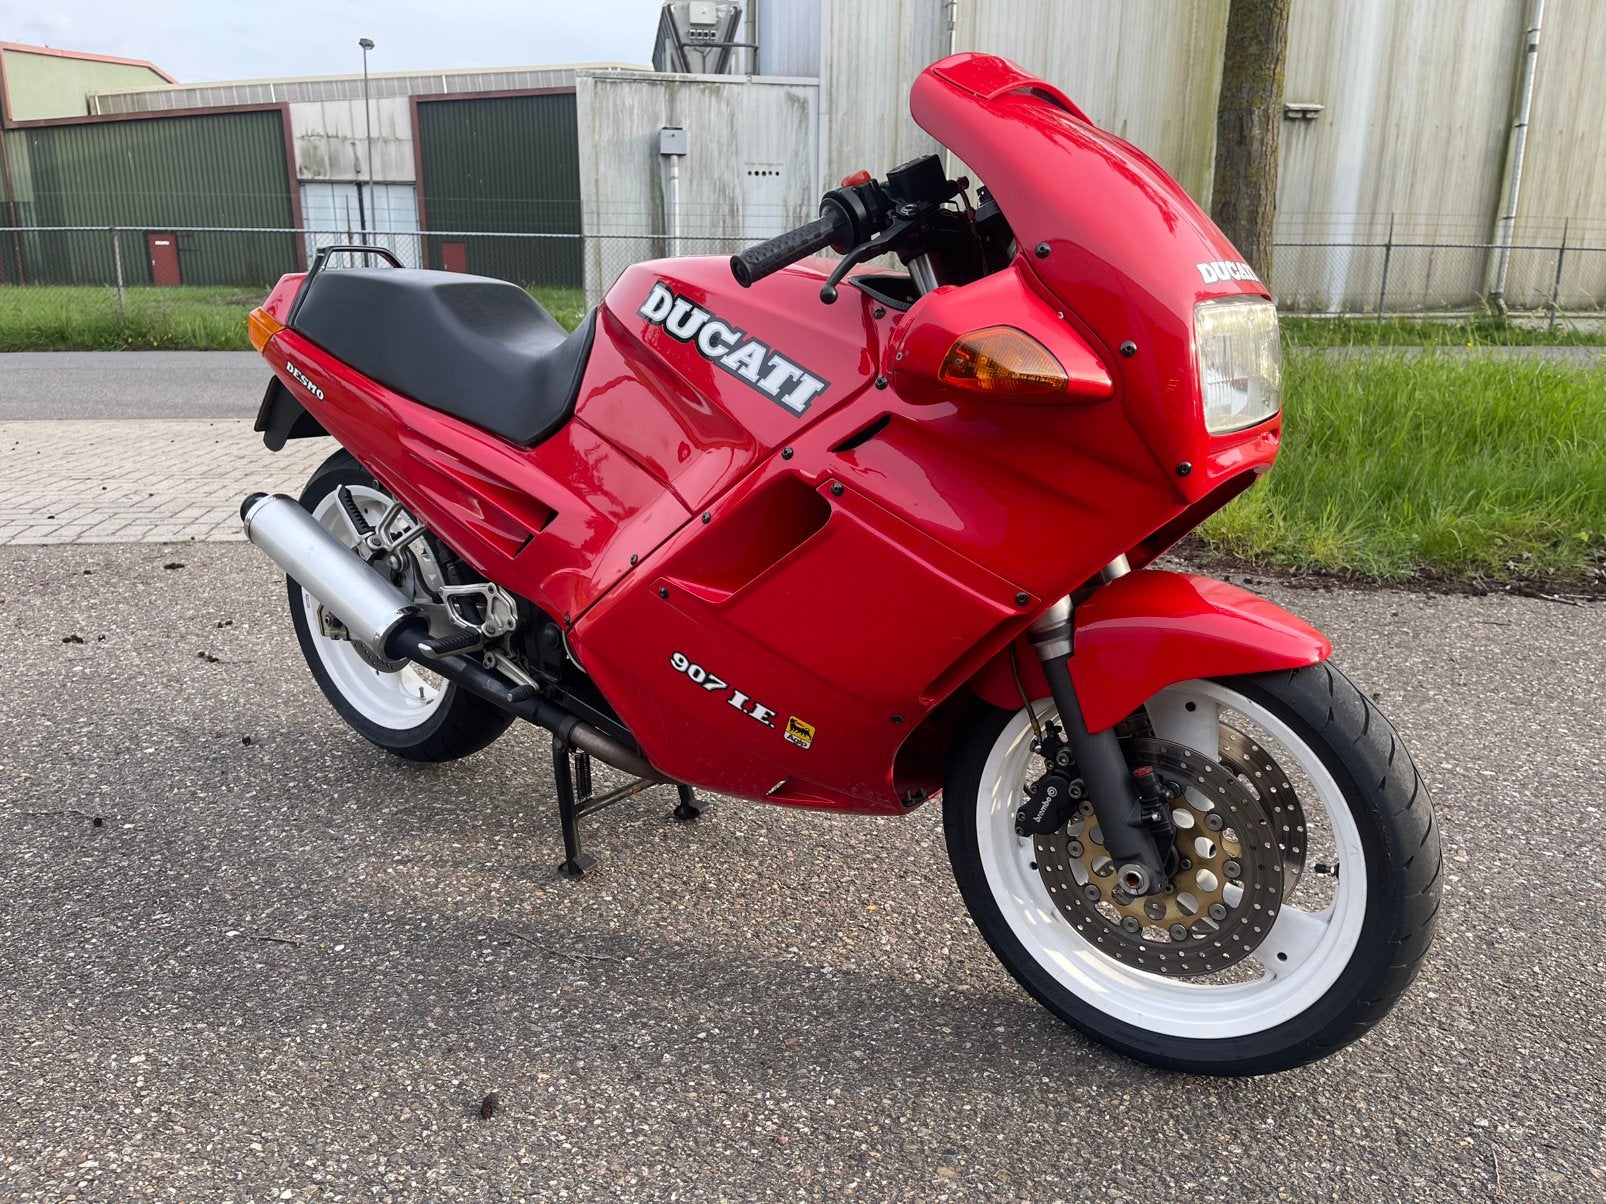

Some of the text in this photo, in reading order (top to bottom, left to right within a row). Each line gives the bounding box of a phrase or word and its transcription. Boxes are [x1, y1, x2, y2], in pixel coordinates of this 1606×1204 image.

[637, 281, 828, 416] DUCATI
[286, 360, 324, 400] DESMO
[670, 651, 777, 729] 907 I.E.
[1033, 796, 1052, 823] brembo
